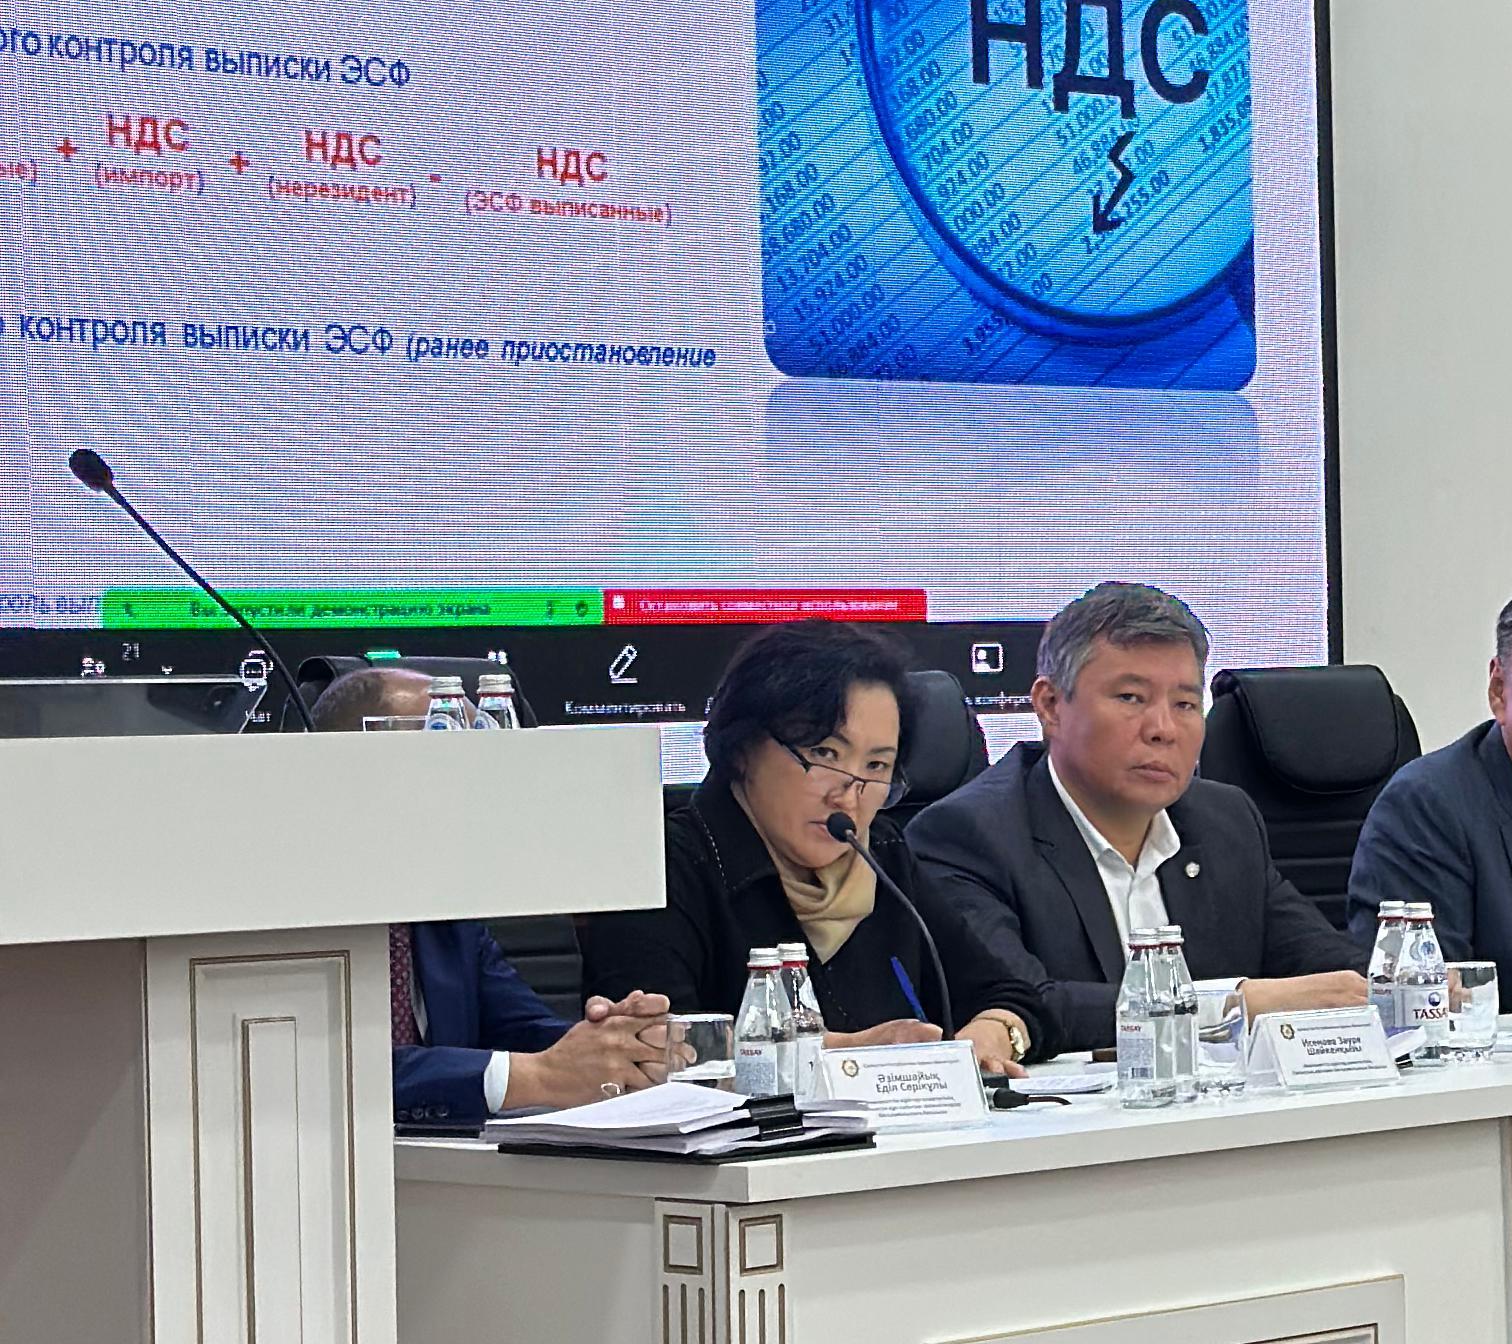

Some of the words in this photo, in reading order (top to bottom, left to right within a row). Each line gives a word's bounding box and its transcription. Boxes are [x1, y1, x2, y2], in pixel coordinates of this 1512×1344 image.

[48, 32, 195, 73] контроля
[205, 47, 332, 82] выписки
[341, 53, 411, 88] ЭСФ
[106, 112, 189, 156] НДС
[304, 128, 383, 171] НДС
[536, 146, 608, 187] НДС
[95, 161, 204, 196] (импорт)
[267, 174, 417, 210] (нерезидент)
[464, 188, 523, 216] (ЭСФ
[529, 199, 672, 228] выписанные)
[19, 313, 167, 350] контроля
[183, 321, 310, 353] выписки
[324, 323, 394, 355] ЭСФ
[406, 331, 489, 363] (ранее
[501, 336, 716, 368] приостановление
[121, 642, 141, 661] 21
[1413, 1007, 1449, 1020] TASSA
